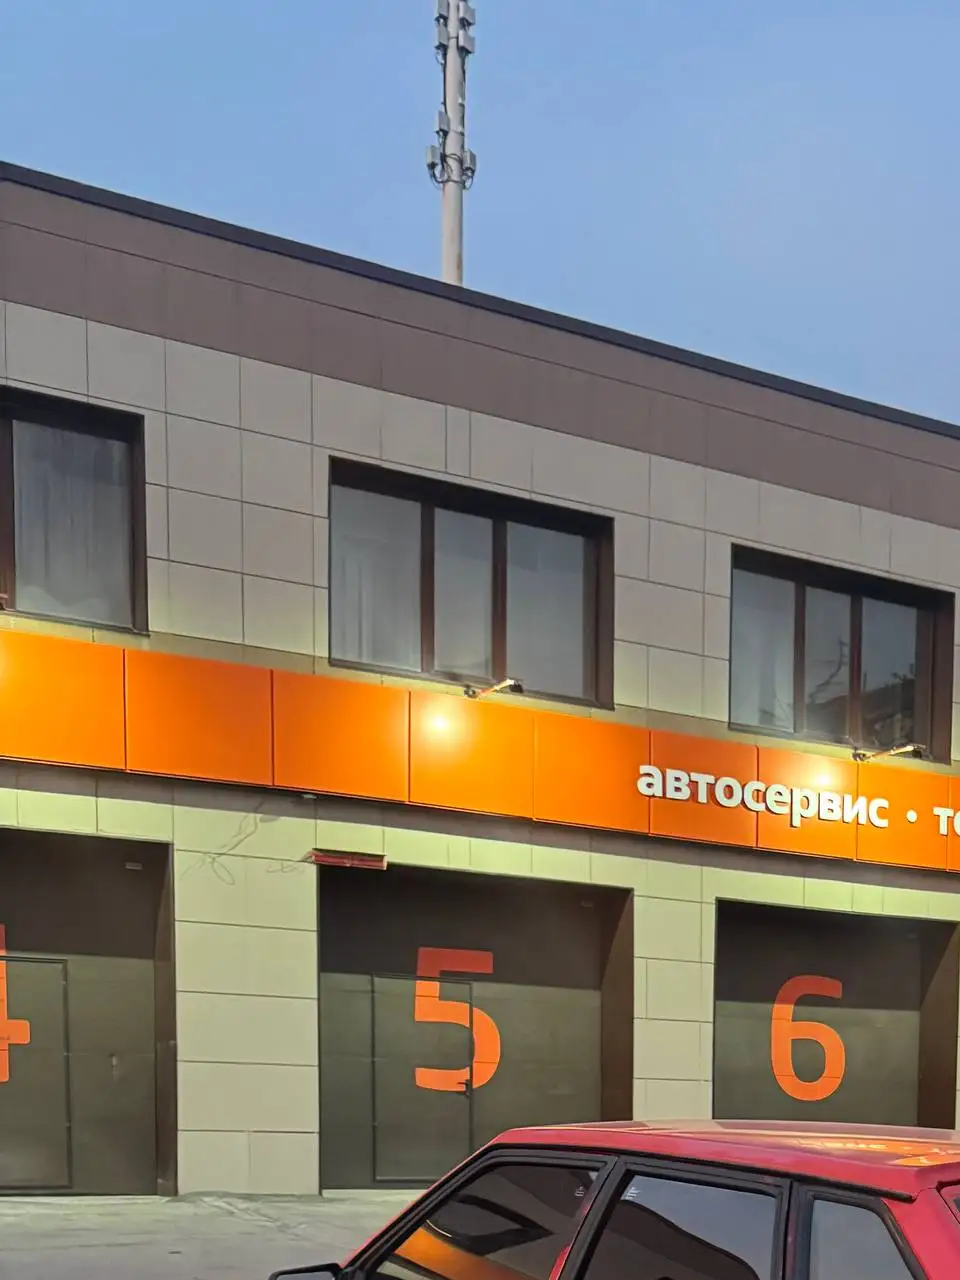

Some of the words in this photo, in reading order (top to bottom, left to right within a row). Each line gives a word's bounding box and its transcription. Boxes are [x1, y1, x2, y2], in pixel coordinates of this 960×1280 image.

[637, 764, 889, 827] автосервис
[415, 947, 501, 1092] 5
[771, 975, 846, 1101] 6
